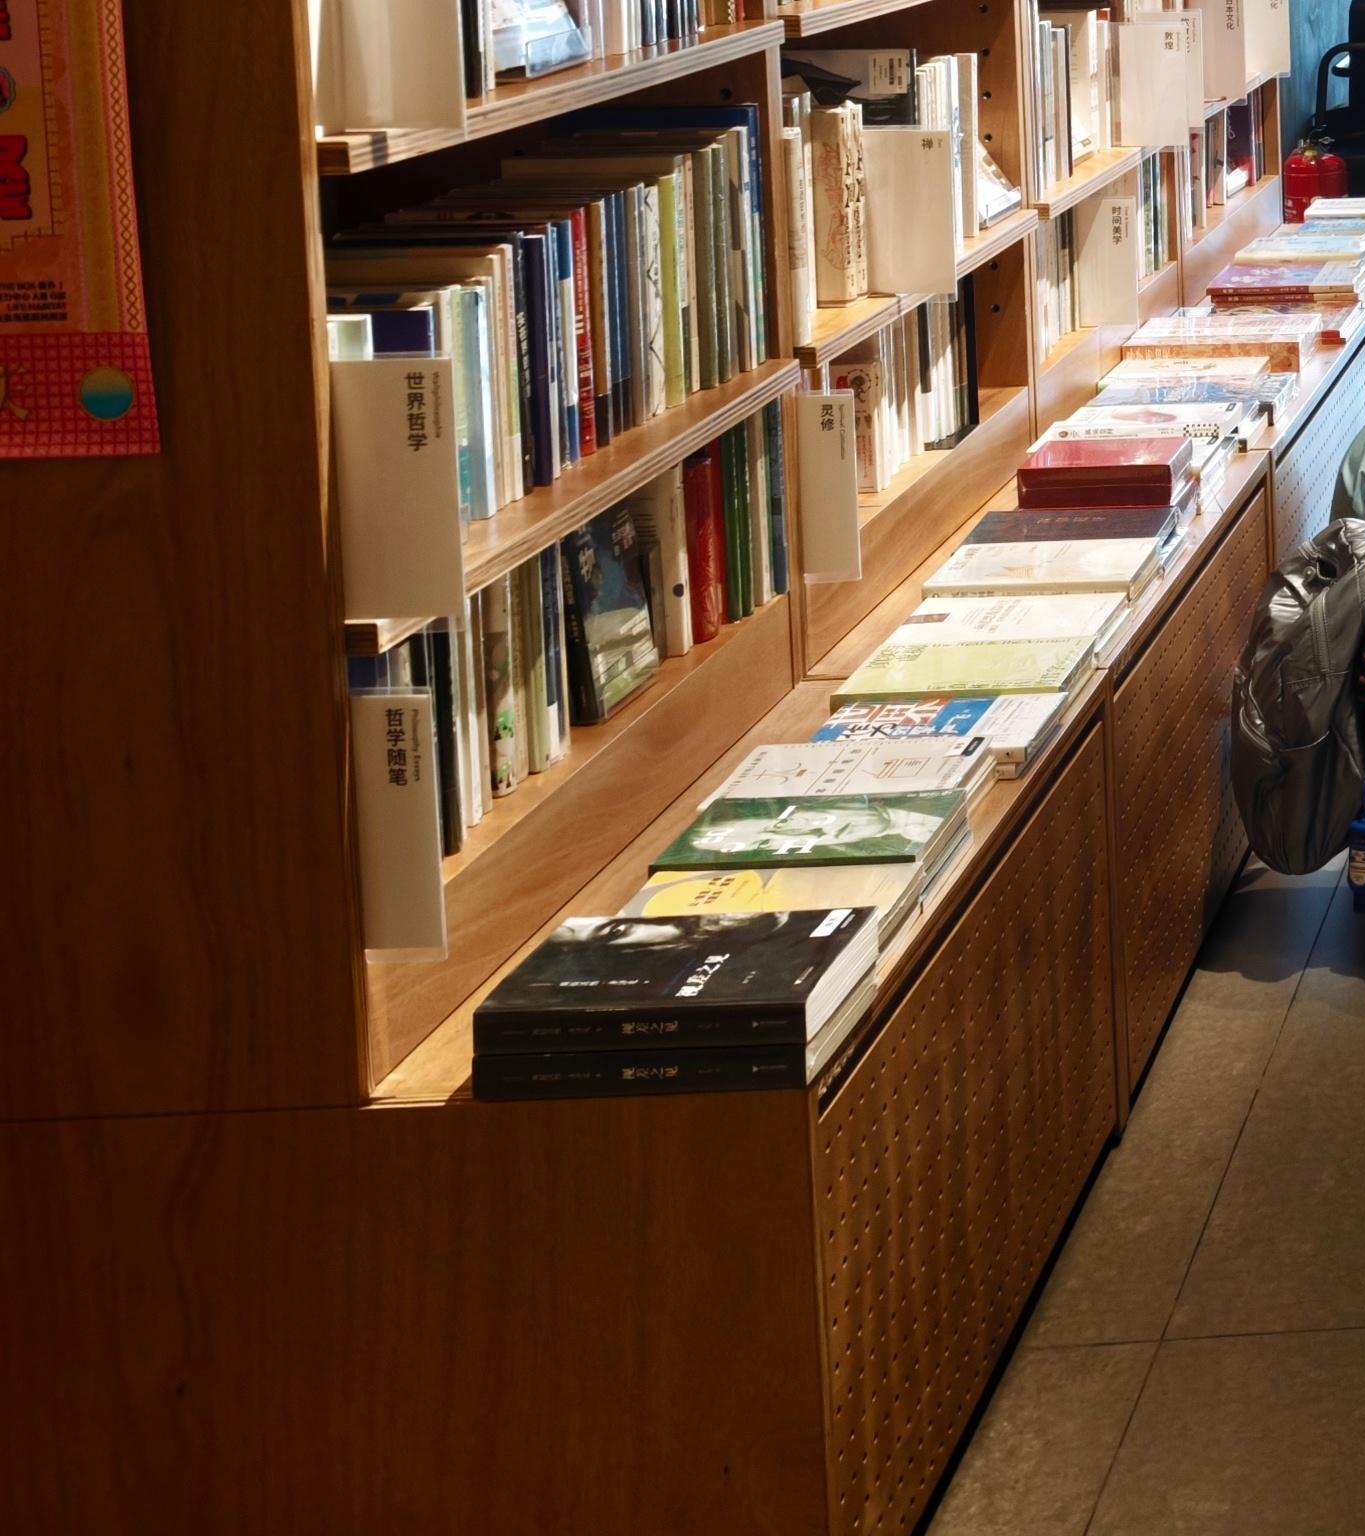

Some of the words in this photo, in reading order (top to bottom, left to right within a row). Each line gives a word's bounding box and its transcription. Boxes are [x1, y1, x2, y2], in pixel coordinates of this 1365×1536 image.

[1164, 31, 1174, 50] 敦煌
[1112, 206, 1122, 245] 时间美学
[404, 371, 429, 452] 世界哲学
[820, 404, 835, 432] 灵修
[385, 708, 408, 787] 哲学随笔
